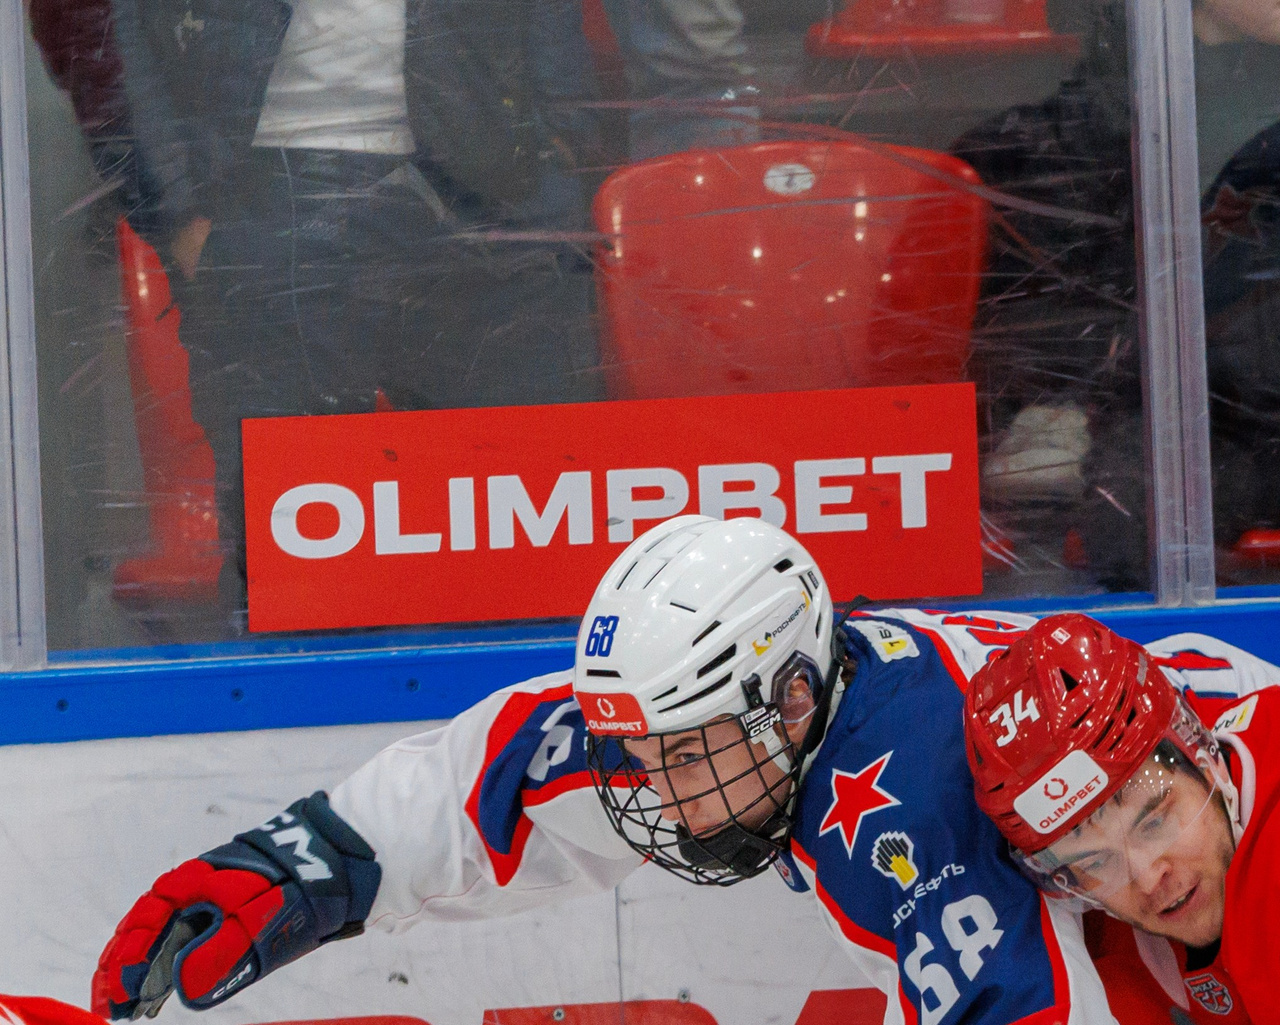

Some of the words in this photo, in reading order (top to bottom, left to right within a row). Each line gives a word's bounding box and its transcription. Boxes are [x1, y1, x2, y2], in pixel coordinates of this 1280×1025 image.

[271, 453, 953, 559] OLIMPBET
[585, 616, 619, 657] 68
[588, 720, 642, 731] OLIMPBET
[750, 712, 781, 737] CCM
[989, 689, 1041, 747] 34
[1039, 775, 1102, 829] OLIMPBET
[212, 963, 252, 999] CCM
